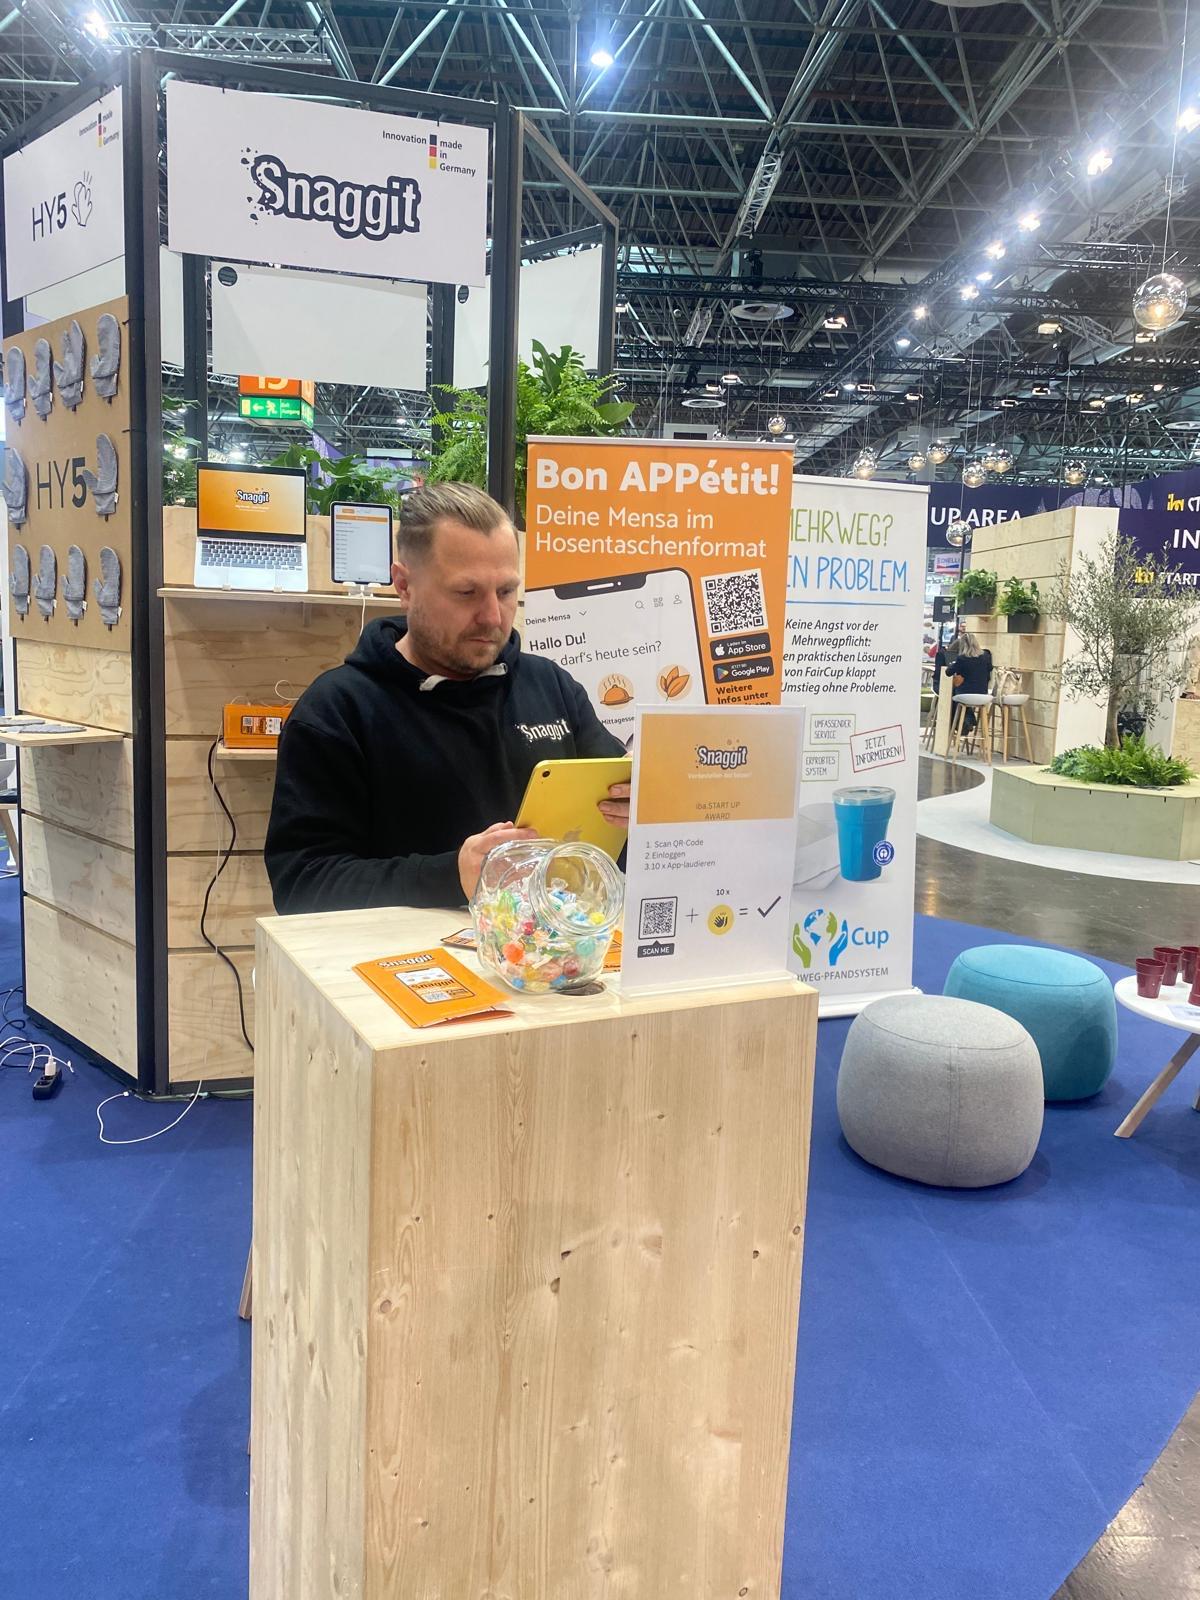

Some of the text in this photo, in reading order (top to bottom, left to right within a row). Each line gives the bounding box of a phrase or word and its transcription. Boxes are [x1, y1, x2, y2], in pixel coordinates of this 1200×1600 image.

[382, 130, 427, 144] Innovation
[439, 140, 463, 150] made
[439, 150, 448, 159] in
[439, 162, 476, 177] Germany
[252, 155, 420, 240] Snaggit
[31, 192, 68, 243] HY5
[36, 456, 88, 511] HY5
[536, 458, 780, 496] Bon APPétit!
[236, 489, 270, 504] Snaggit
[536, 504, 714, 530] Deine Mensa im
[930, 506, 961, 526] UP
[535, 532, 767, 558] Hosentaschenformat
[816, 556, 911, 593] PROBLEM.
[525, 613, 571, 625] Deine Mensa
[785, 618, 880, 632] Keine Angst vor der
[529, 632, 587, 651] Hallo Du!
[727, 643, 766, 655] App Store
[791, 634, 872, 649] Mehrwegpflicht:
[560, 640, 662, 666] darf's heute sein?
[783, 651, 903, 665] en praktischen Lösungen
[731, 665, 770, 677] Google Play
[784, 667, 876, 679] von FairCup klappt
[716, 684, 753, 695] Weitere
[822, 683, 849, 693] ohne
[850, 683, 897, 693] Probleme.
[743, 692, 769, 701] unter
[601, 715, 635, 726] Mittagesse
[518, 718, 571, 741] Snaggit
[814, 730, 836, 739] SERVICE
[864, 735, 886, 750] JETZT
[698, 745, 748, 770] Snaggit
[654, 840, 672, 848] Scan
[652, 851, 686, 860] Einloggen
[851, 926, 890, 949] Cup
